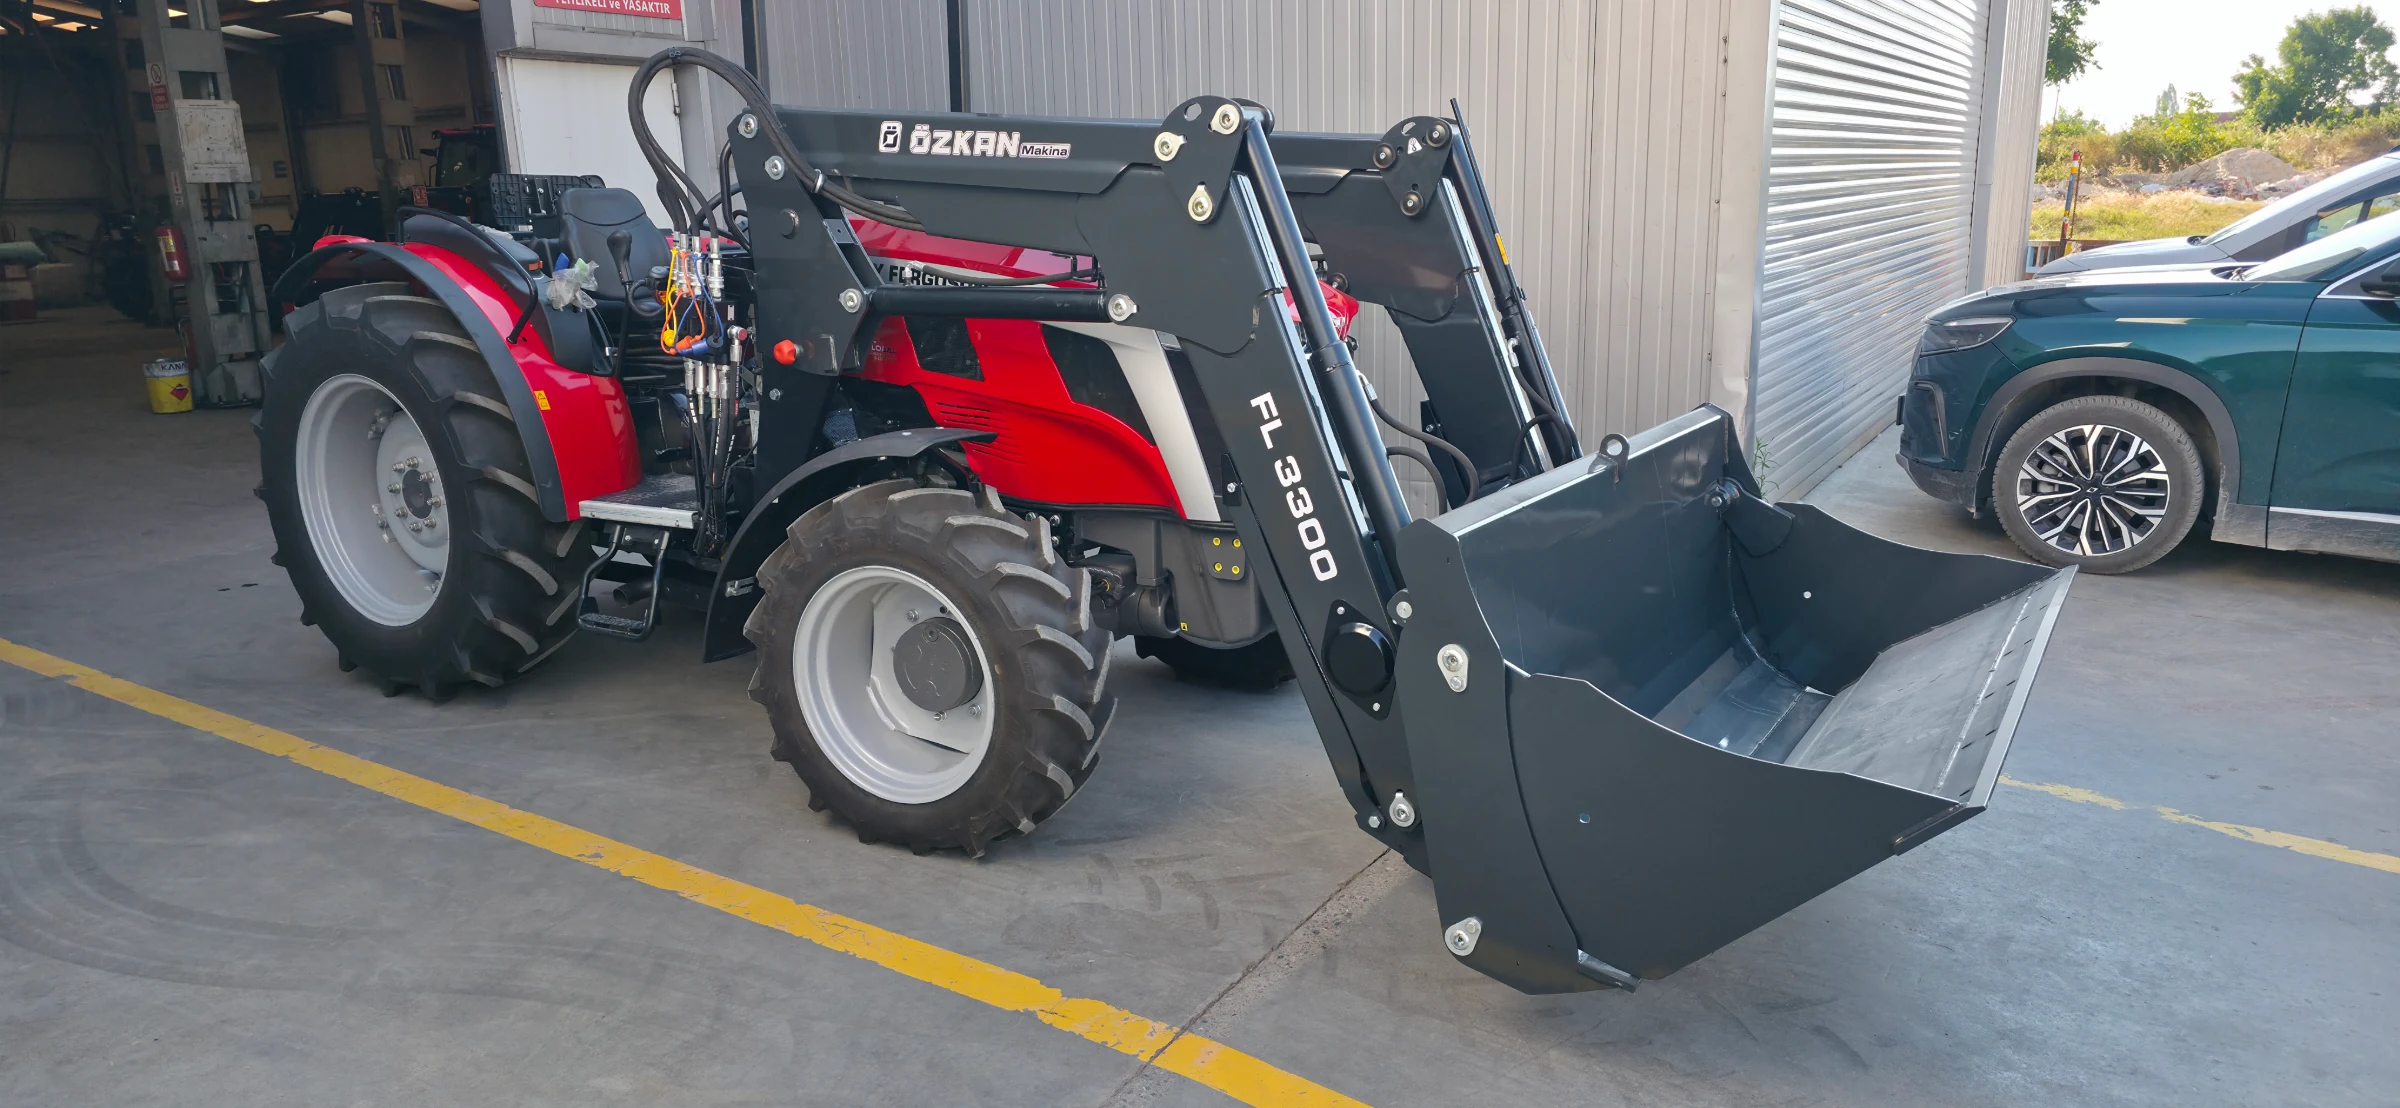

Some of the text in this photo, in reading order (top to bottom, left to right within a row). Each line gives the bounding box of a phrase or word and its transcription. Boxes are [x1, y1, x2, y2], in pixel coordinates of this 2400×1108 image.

[609, 1, 621, 10] ve
[623, 0, 671, 14] YASAKTIR
[910, 124, 1020, 157] ÖZKAN
[1021, 144, 1068, 157] Makina
[889, 265, 988, 287] FERGU
[1250, 392, 1338, 582] FL 3300
